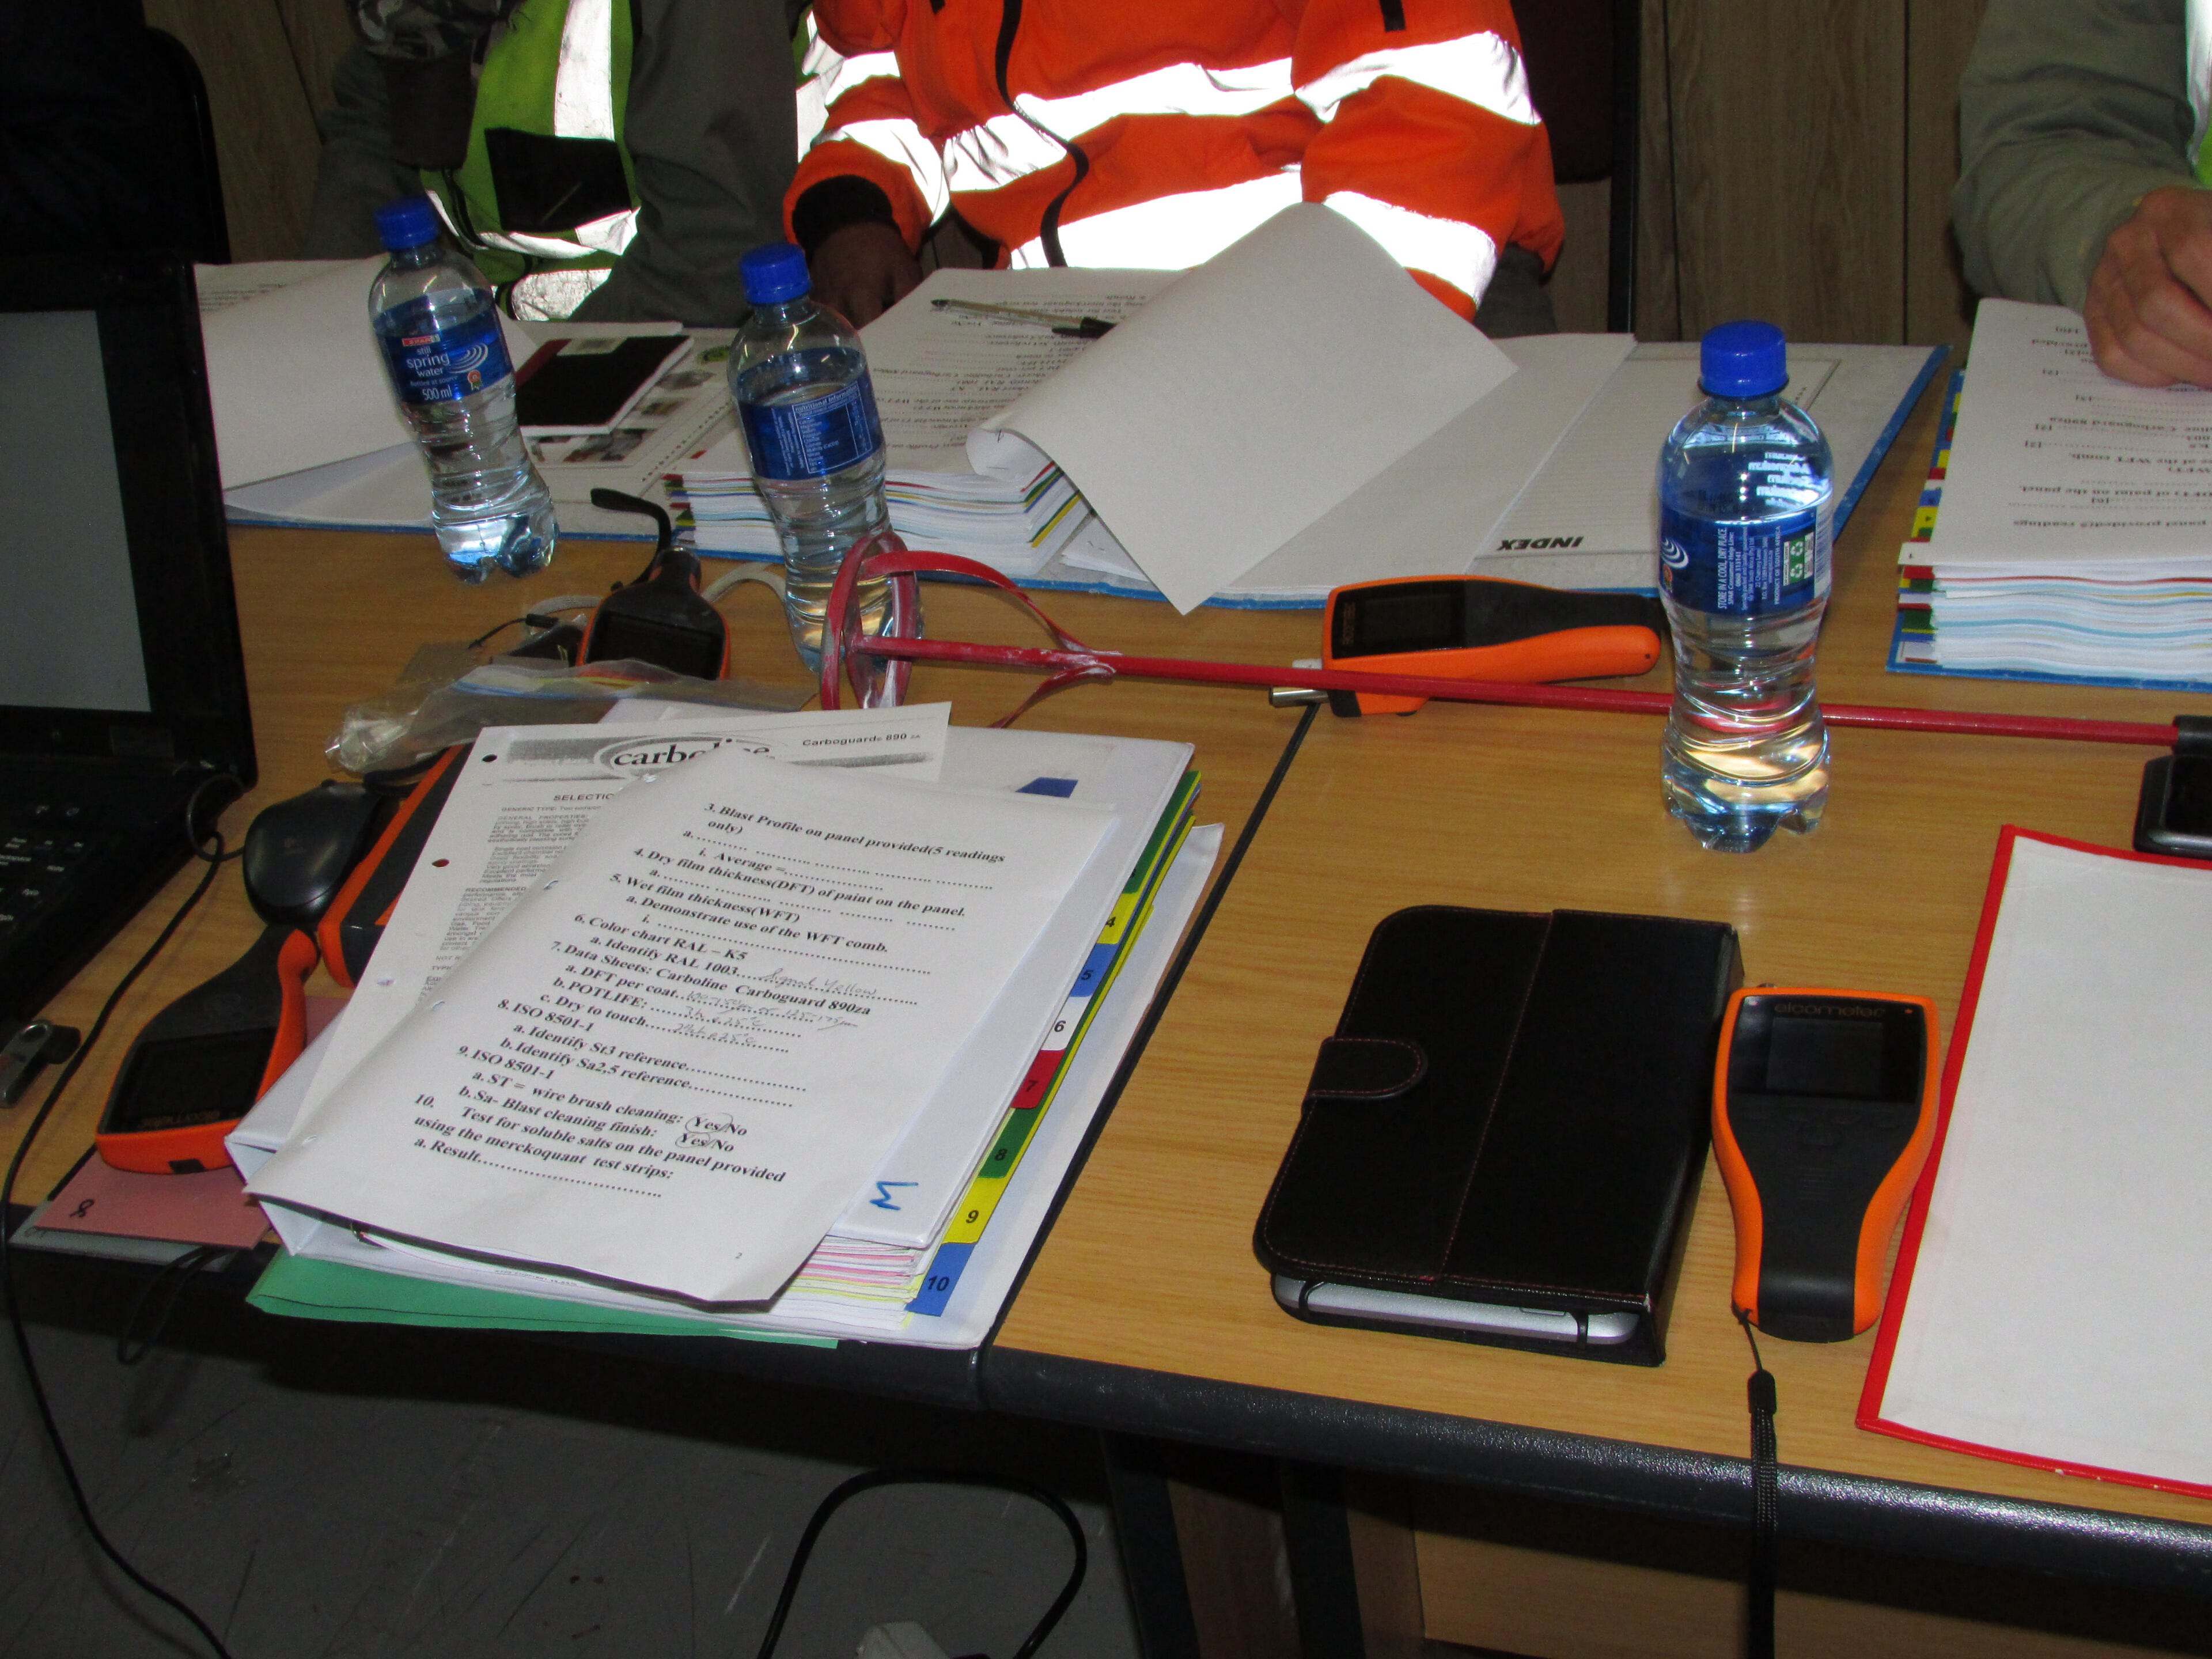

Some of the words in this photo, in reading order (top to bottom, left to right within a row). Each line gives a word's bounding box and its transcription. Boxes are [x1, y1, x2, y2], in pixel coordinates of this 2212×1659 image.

[416, 347, 431, 355] still
[406, 353, 450, 369] spring
[416, 368, 444, 377] water
[422, 387, 439, 400] 500
[441, 385, 452, 397] ml
[1497, 536, 1584, 551] INDEX
[1718, 547, 1727, 559] DRY
[1718, 591, 1727, 609] STORE
[886, 733, 907, 741] 890
[704, 803, 715, 812] 3.
[719, 806, 754, 821] Blast
[756, 815, 802, 832] Profile
[806, 828, 823, 836] on
[824, 832, 865, 844] panel
[946, 850, 1005, 863] readings
[708, 820, 743, 834] only)
[715, 853, 772, 871] Average
[634, 848, 643, 857] 4.
[647, 851, 673, 865] Dry
[677, 858, 704, 872] film
[709, 866, 815, 895] thickness(DFT)
[818, 888, 835, 897] of
[834, 893, 873, 904] paint
[876, 899, 893, 907] on
[897, 900, 920, 910] the
[922, 904, 965, 916] panel.
[610, 873, 622, 882] 5.
[627, 877, 654, 891] Wet
[656, 885, 684, 899] film
[688, 894, 800, 922] thickness(WFT)
[641, 897, 730, 925] Demonstrate
[734, 921, 757, 930] use
[760, 925, 778, 934] of
[778, 928, 801, 938] the
[806, 931, 844, 945] WFT
[846, 940, 887, 952] comb.
[1105, 916, 1116, 927] 4
[574, 914, 586, 923] 6.
[589, 917, 630, 934] Color
[632, 930, 671, 945] chart
[673, 938, 707, 952] RAL
[724, 949, 748, 960] K5
[605, 938, 662, 960] Identify
[664, 953, 699, 968] RAL
[551, 941, 560, 951] 7.
[563, 944, 598, 961] Data
[601, 955, 652, 974] Sheets:
[656, 968, 728, 991] Carboline
[736, 985, 826, 1007] Carboguard
[828, 1000, 871, 1015] 890za
[580, 967, 617, 982] DFT
[615, 978, 644, 989] per
[1081, 969, 1094, 980] 5
[568, 980, 647, 1008] POTLIFE:
[555, 995, 585, 1012] Dry
[587, 1005, 602, 1015] to
[1774, 1002, 1886, 1017] elcometer
[498, 999, 509, 1009] 8.
[512, 1003, 543, 1018] ISO
[544, 1012, 594, 1032] 8501-1
[1054, 1020, 1066, 1033] 6
[528, 1027, 588, 1050] Identify
[590, 1042, 616, 1055] St3
[457, 1045, 468, 1058] 9.
[471, 1048, 503, 1066] ISO
[505, 1058, 556, 1080] 8501-1
[514, 1041, 575, 1066] Identify
[576, 1058, 620, 1075] Sa2,5
[1024, 1080, 1039, 1093] 7
[487, 1074, 513, 1088] ST
[532, 1088, 566, 1102] wire
[567, 1093, 612, 1112] brush
[615, 1105, 684, 1124] cleaning:
[694, 1116, 748, 1136] Yes/No
[502, 1097, 542, 1115] Blast
[544, 1109, 607, 1131] cleaning
[609, 1122, 658, 1137] finish:
[680, 1132, 735, 1153] Yes/No
[414, 1117, 456, 1137] using
[457, 1128, 483, 1142] the
[593, 1156, 622, 1170] test
[623, 1162, 674, 1179] strips:
[415, 1094, 434, 1108] 10.
[461, 1106, 494, 1124] Test
[495, 1117, 520, 1130] for
[521, 1125, 575, 1143] soluble
[577, 1137, 612, 1150] salts
[615, 1142, 634, 1153] on
[638, 1145, 664, 1158] the
[662, 1151, 713, 1167] panel
[710, 1160, 786, 1183] provided
[994, 1148, 1008, 1161] 8
[965, 1210, 979, 1224] 9
[926, 1276, 950, 1292] 10
